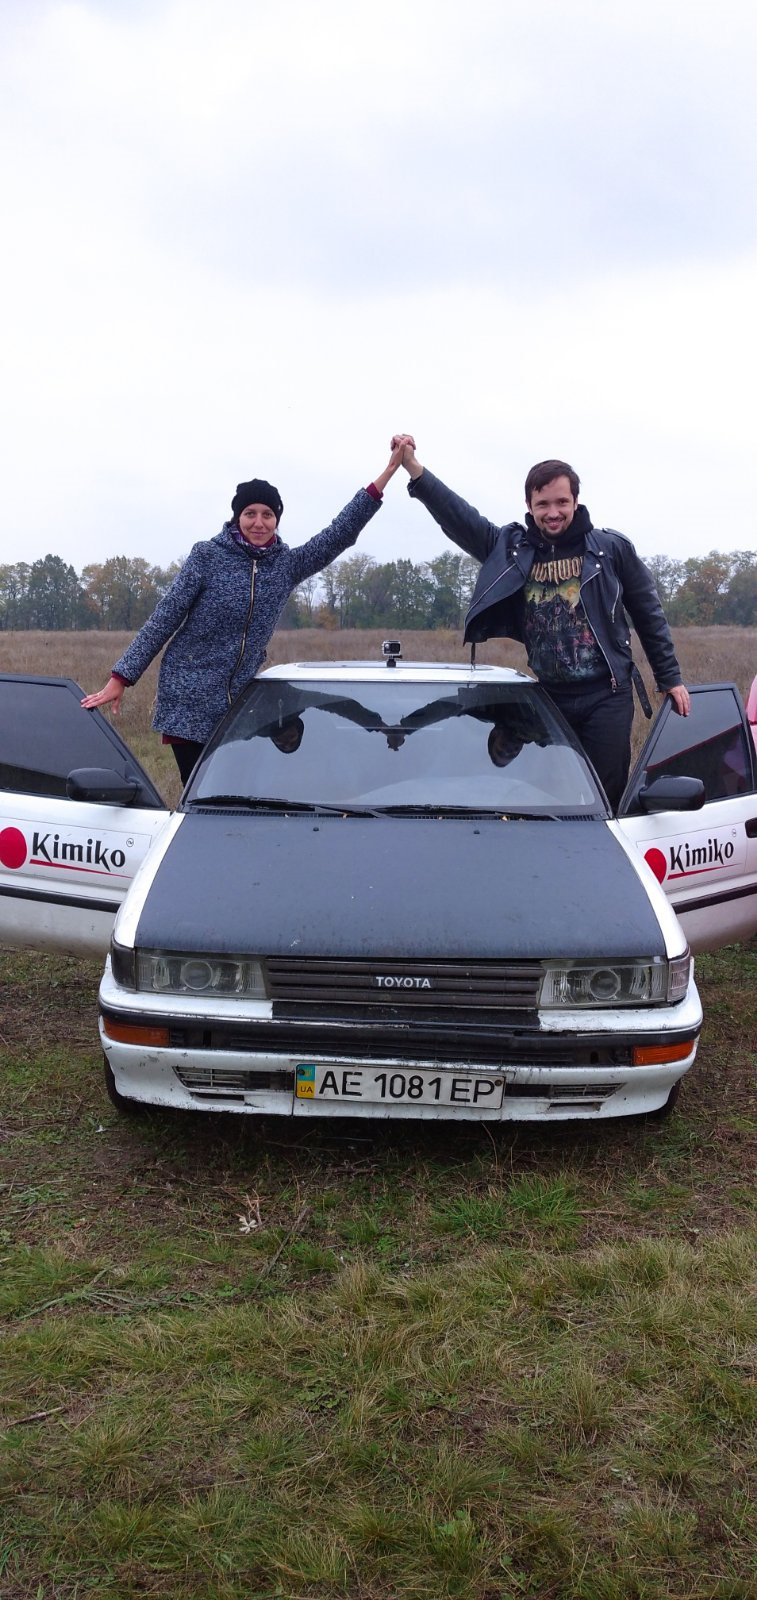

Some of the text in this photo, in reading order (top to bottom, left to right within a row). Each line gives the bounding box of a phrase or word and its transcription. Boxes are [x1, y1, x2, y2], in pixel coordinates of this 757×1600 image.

[32, 832, 126, 872] Kimiko
[669, 838, 734, 873] Kimiko
[375, 976, 431, 988] TOYOTA
[318, 1070, 495, 1103] AE 1081 EP
